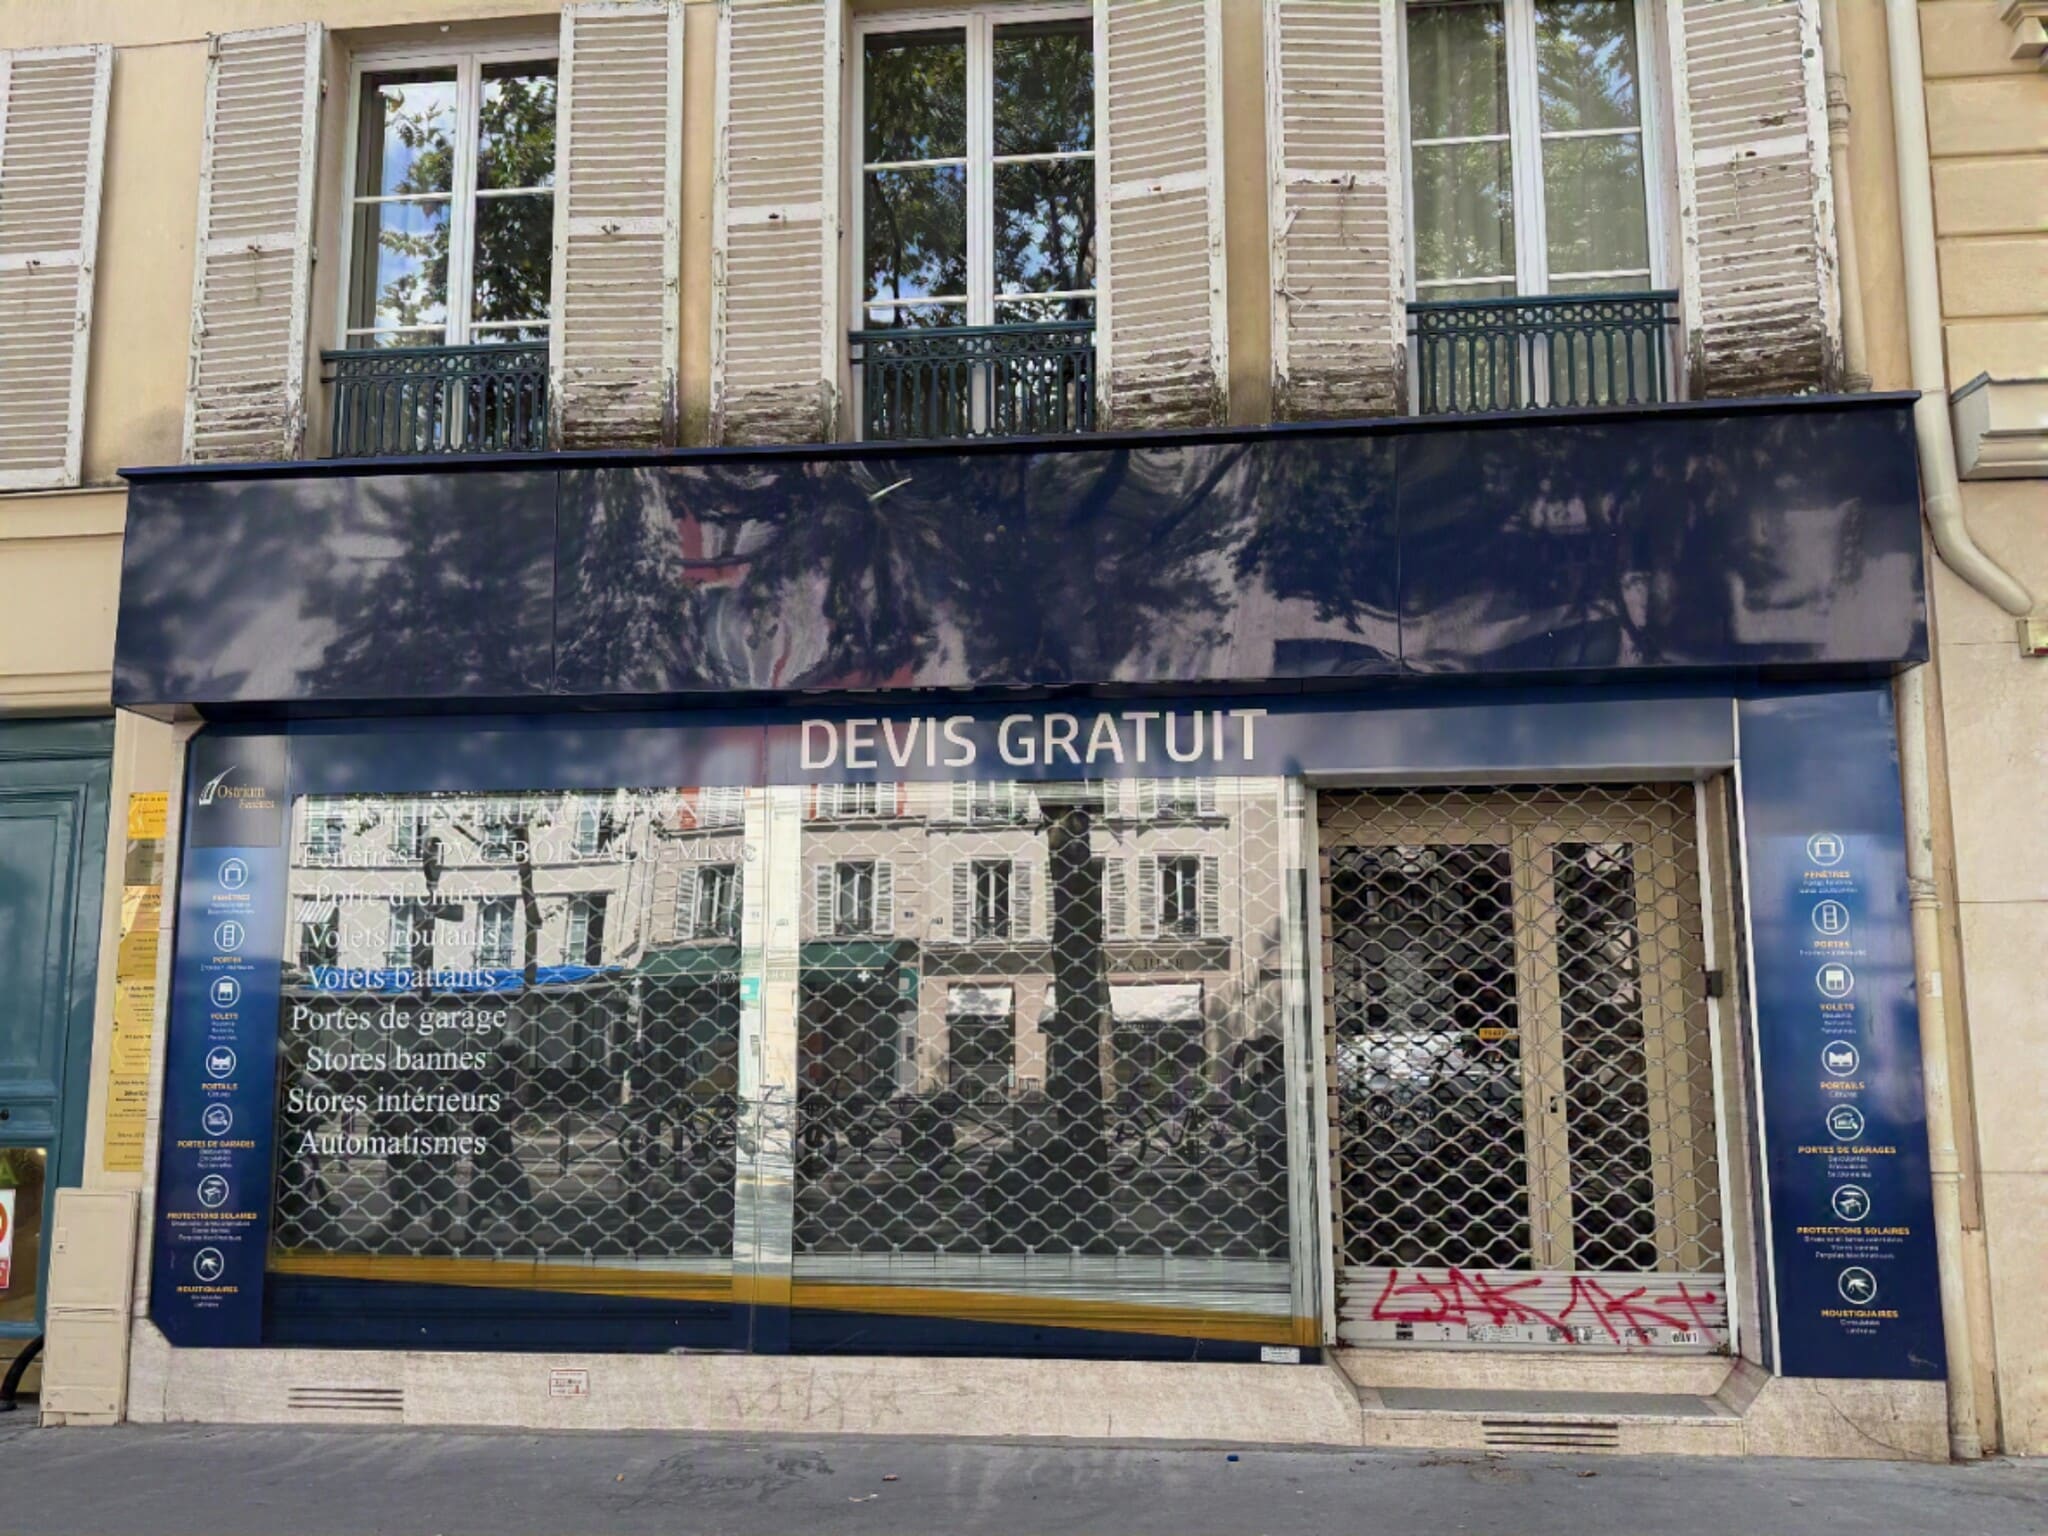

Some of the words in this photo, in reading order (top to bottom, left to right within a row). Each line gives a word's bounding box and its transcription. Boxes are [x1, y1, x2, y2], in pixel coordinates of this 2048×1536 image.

[800, 715, 977, 769] DEVIS
[997, 709, 1268, 766] GRATUIT
[307, 921, 386, 948] Volets
[392, 922, 499, 947] roulants
[308, 964, 385, 990] Volets
[394, 964, 497, 988] battants
[290, 1004, 371, 1031] Portes
[379, 1004, 410, 1029] de
[418, 1009, 508, 1036] garage
[306, 1045, 387, 1072] Stores
[396, 1045, 487, 1071] bannes
[287, 1087, 368, 1114] Stores
[377, 1086, 501, 1113] intérieurs
[297, 1128, 488, 1156] Automatismes
[1797, 1146, 1834, 1154] PORTES
[1853, 1146, 1896, 1154] GARAGES
[1796, 1227, 1862, 1235] PROTECTIONS
[1864, 1227, 1910, 1235] SOLAIRES
[1821, 1310, 1899, 1319] MOUSTIQUAIRES
